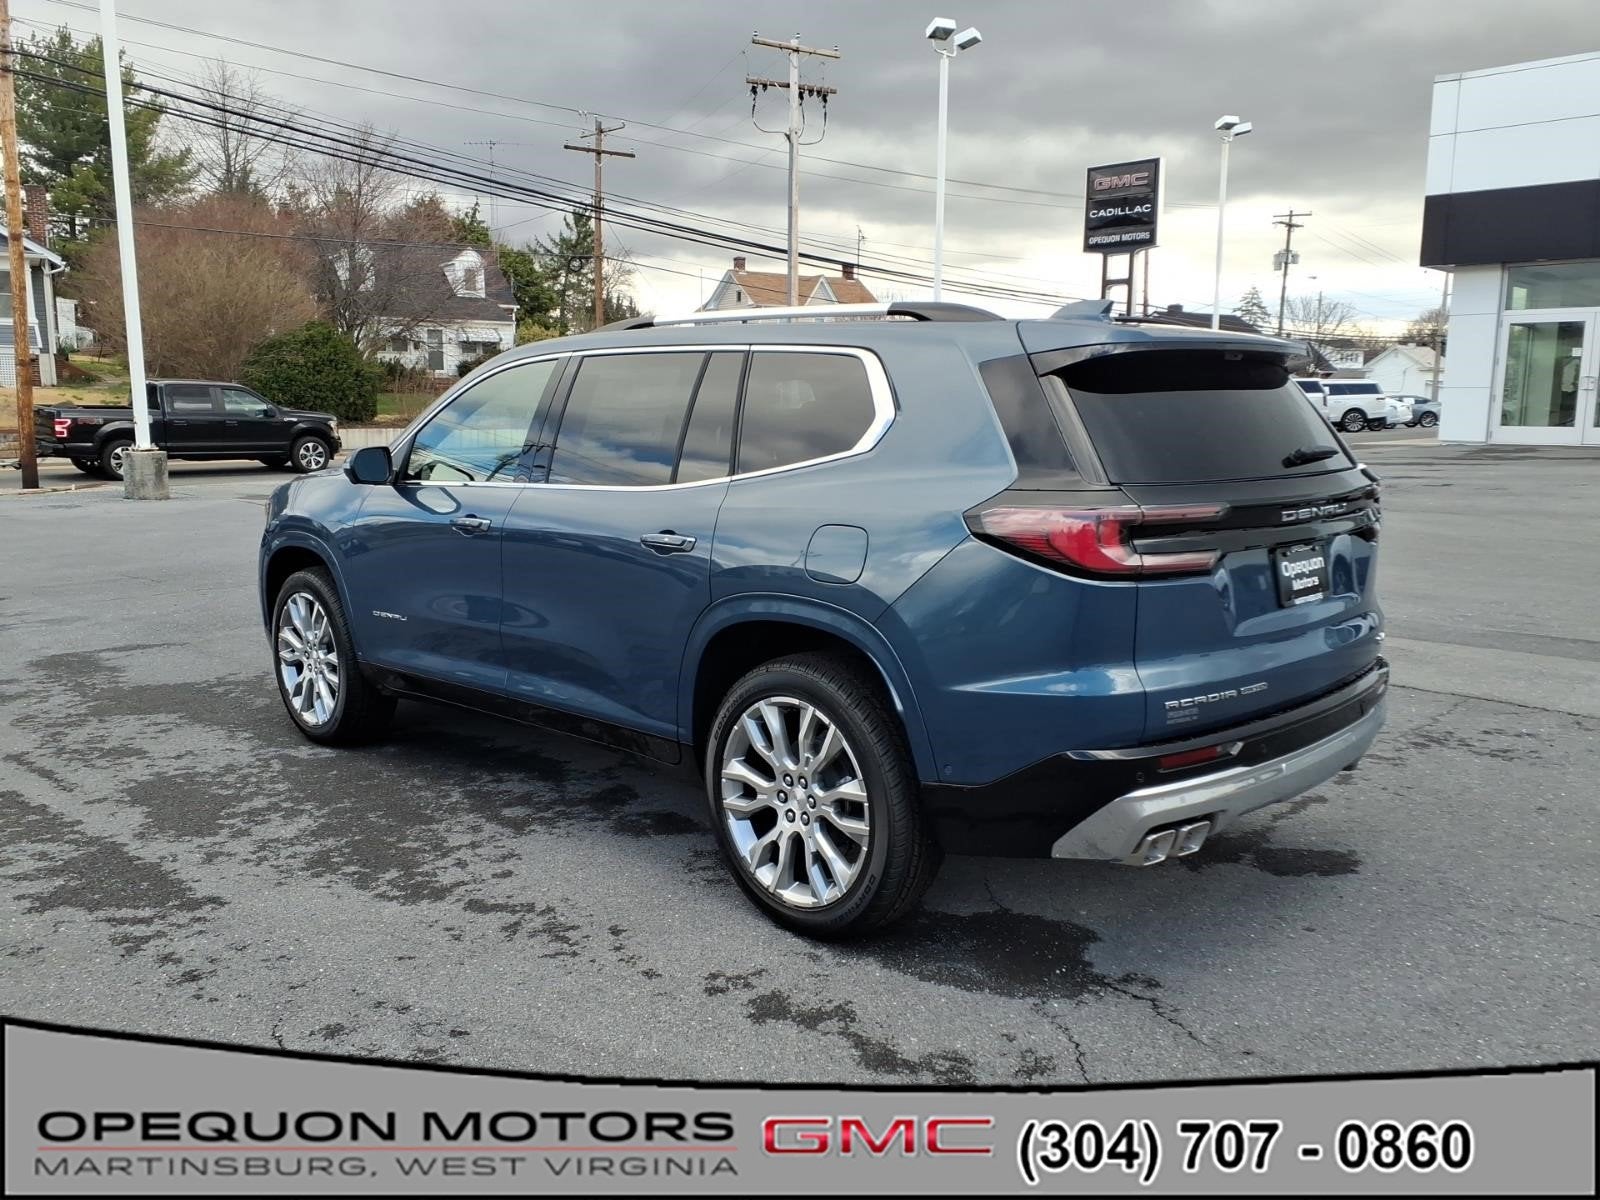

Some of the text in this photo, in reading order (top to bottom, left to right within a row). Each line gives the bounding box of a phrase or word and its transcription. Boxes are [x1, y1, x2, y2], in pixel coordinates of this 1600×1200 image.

[1094, 172, 1150, 191] GMC
[1089, 204, 1153, 218] CADILLAC
[1088, 231, 1151, 245] OPEQUON MOTORS
[1281, 502, 1348, 521] DENALI
[1281, 556, 1325, 578] Opequon
[1291, 576, 1320, 591] Motors
[1164, 689, 1238, 709] ACADIA
